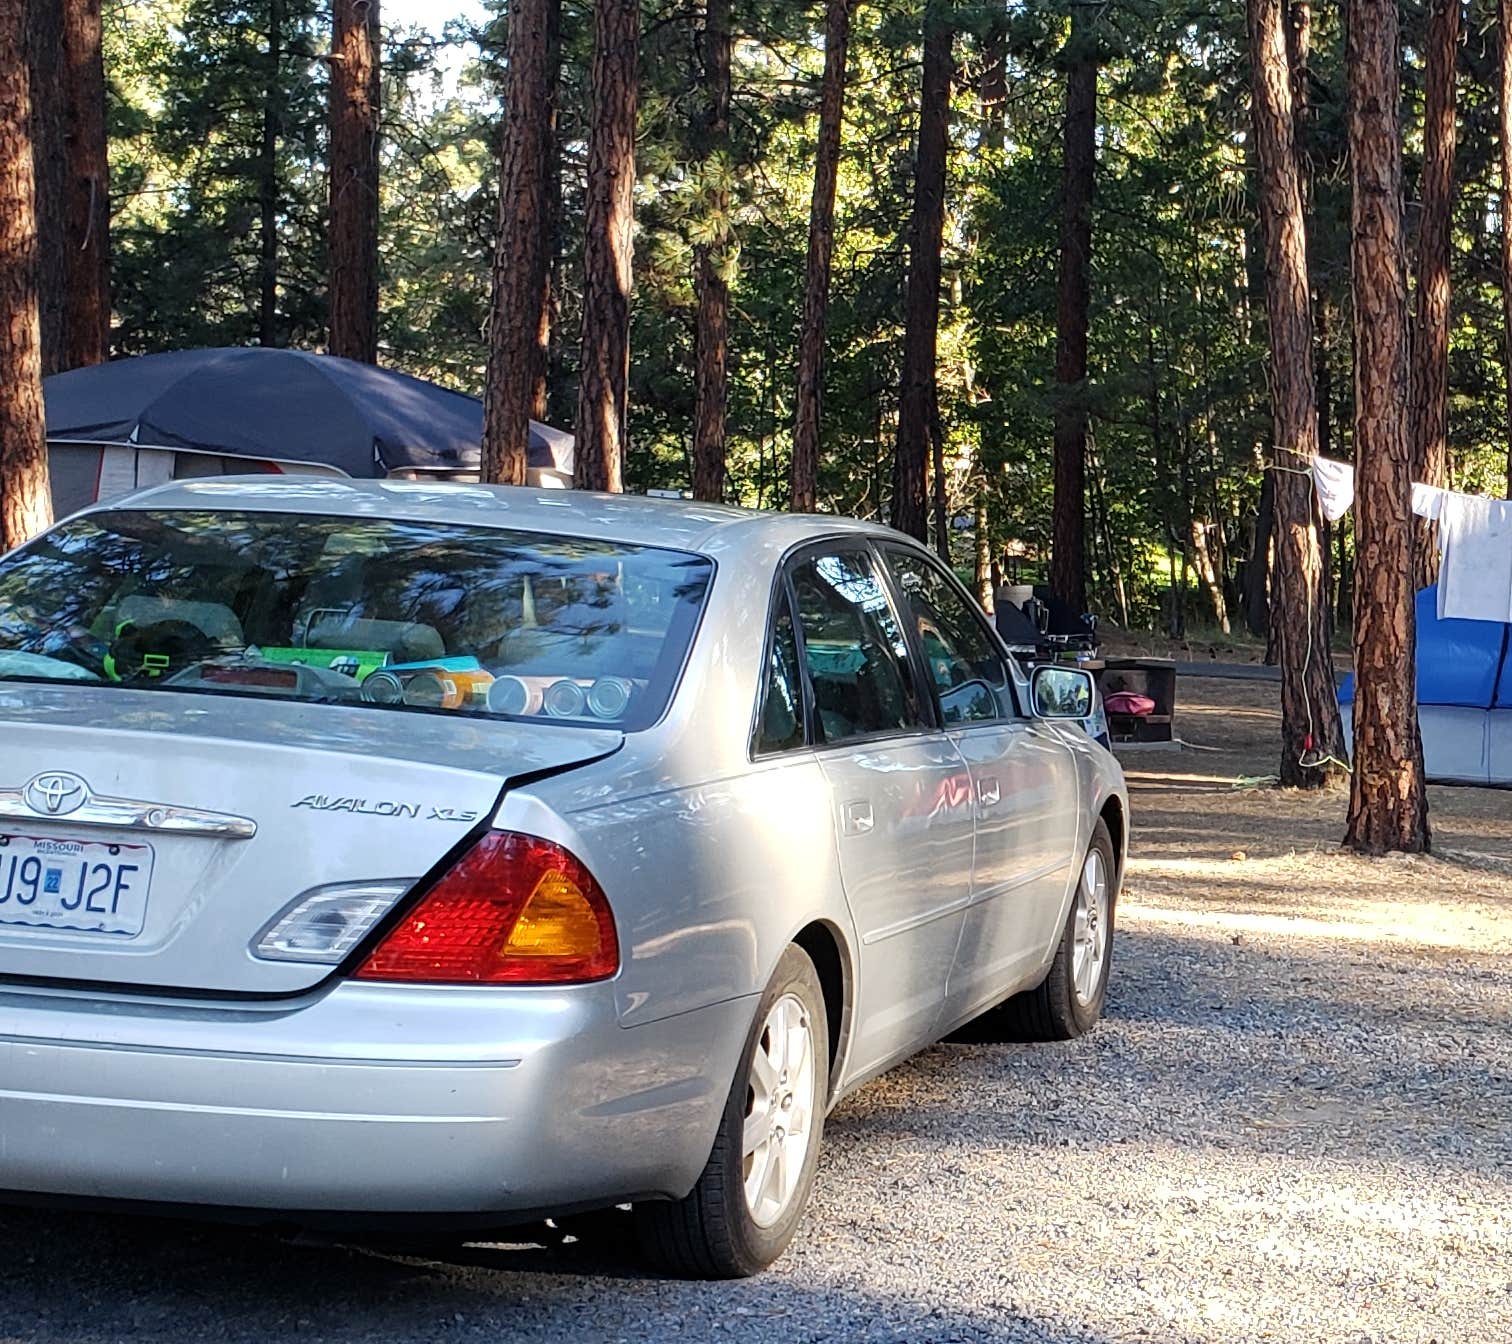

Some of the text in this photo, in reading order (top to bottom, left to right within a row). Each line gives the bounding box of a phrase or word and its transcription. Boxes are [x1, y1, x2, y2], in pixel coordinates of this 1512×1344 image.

[290, 795, 421, 818] AVALON
[33, 840, 84, 853] MISSOURI
[61, 861, 139, 914] J2F
